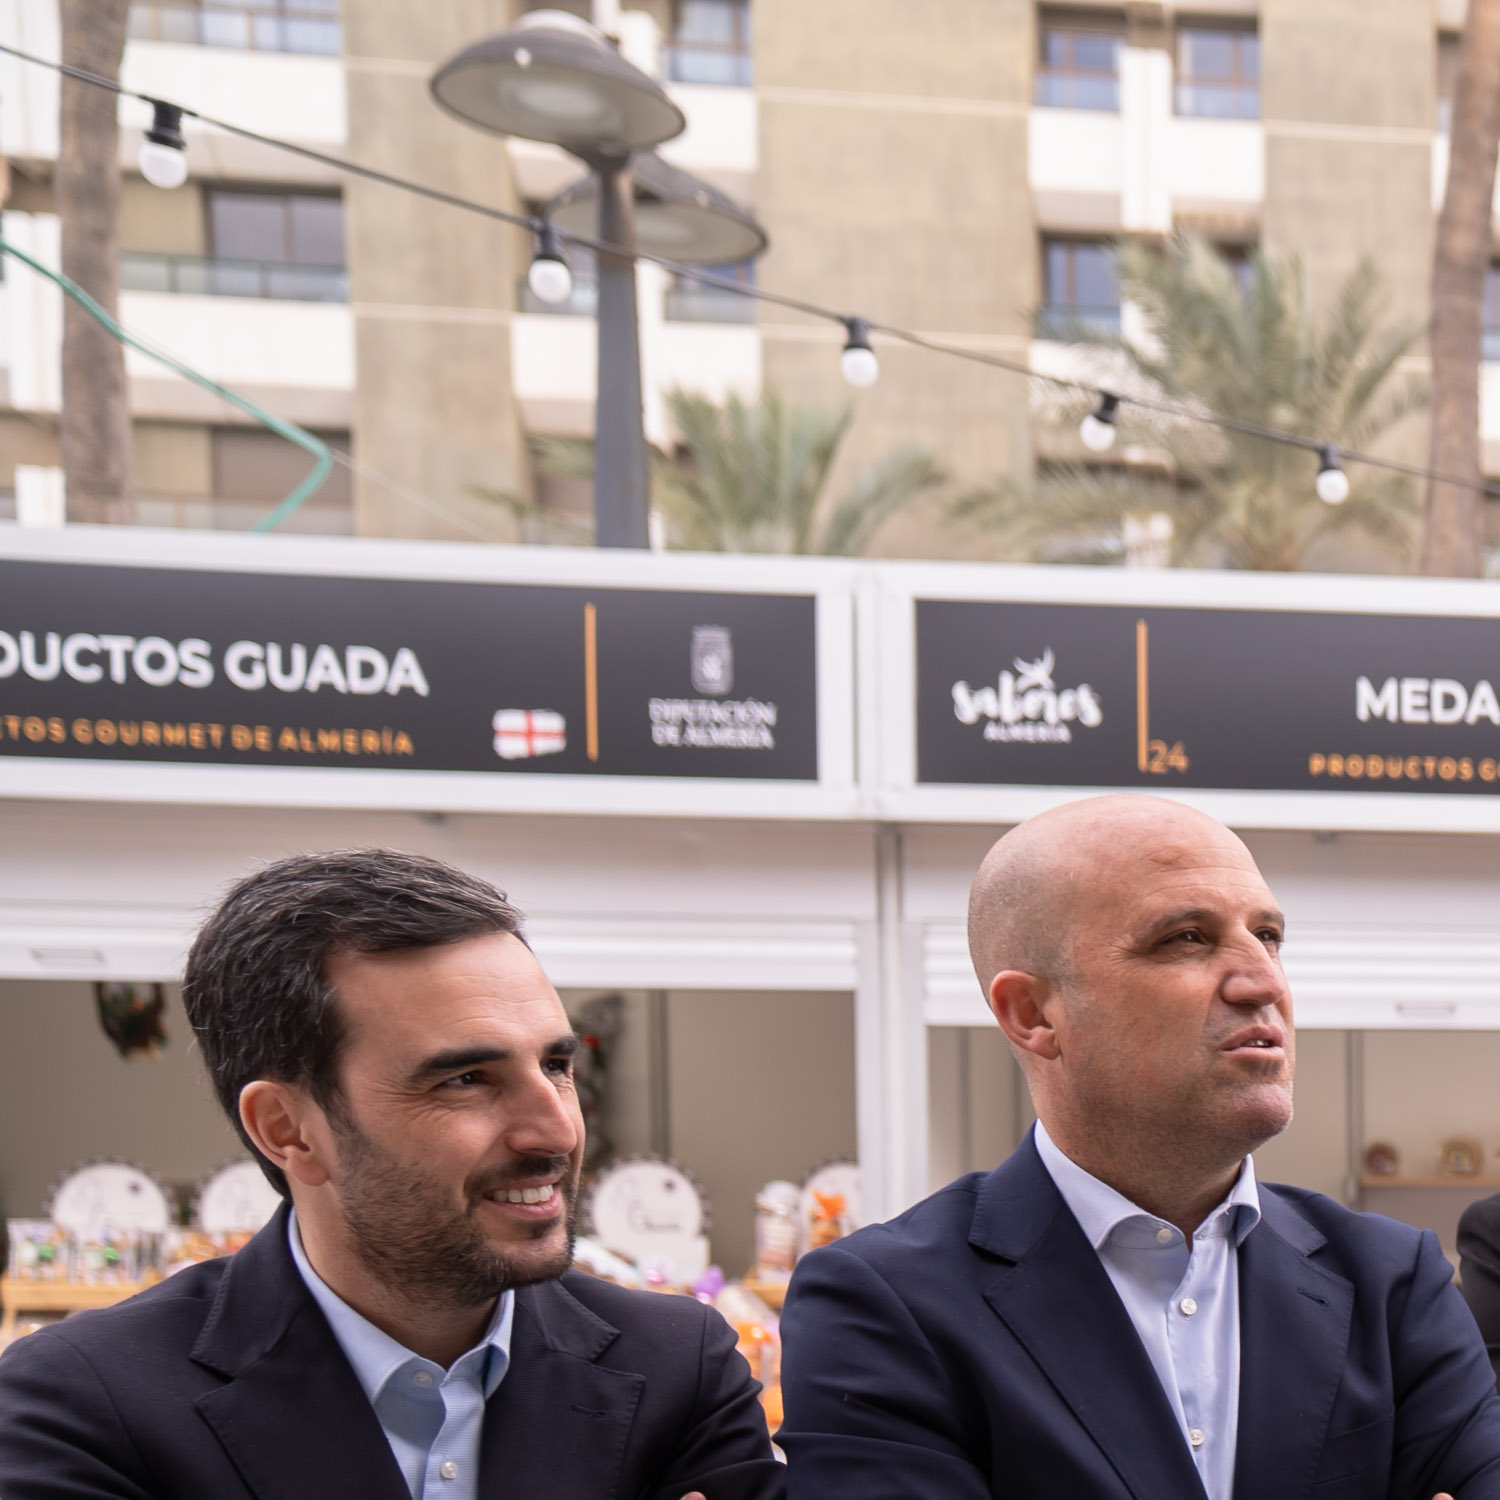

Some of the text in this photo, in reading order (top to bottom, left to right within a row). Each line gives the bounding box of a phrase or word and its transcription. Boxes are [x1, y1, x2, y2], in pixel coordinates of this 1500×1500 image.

[224, 640, 430, 697] GUADA
[0, 715, 415, 757] TOS GOURMET DE ALMERÍA
[1148, 739, 1189, 774] 24
[1309, 752, 1474, 782] PRODUCTOS
